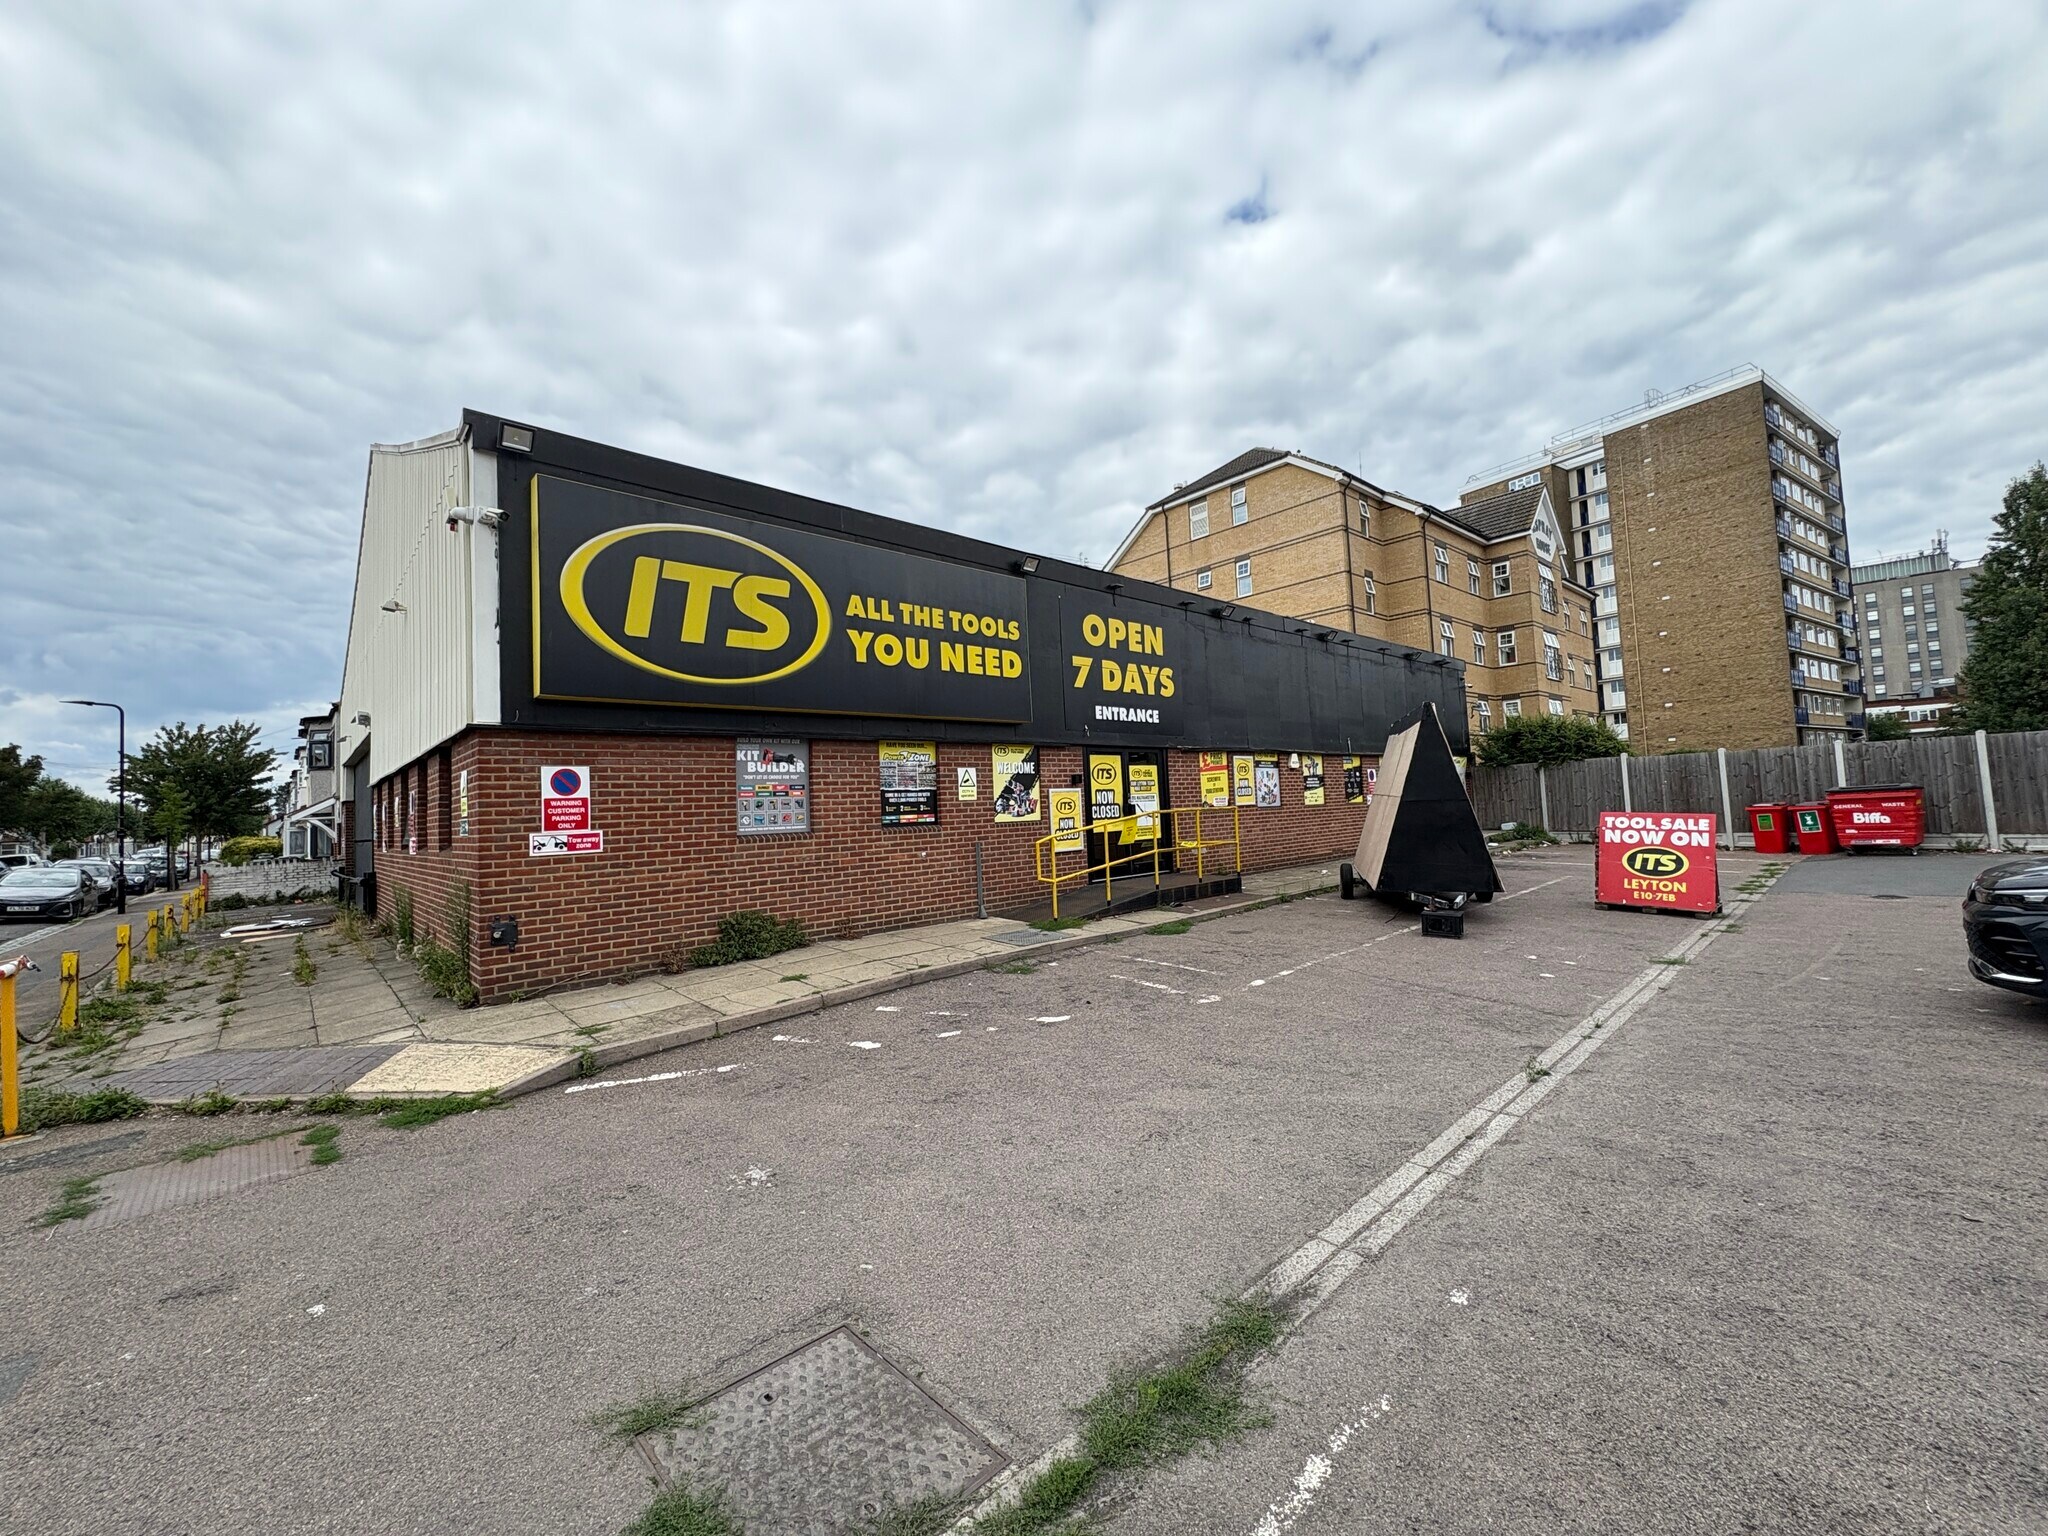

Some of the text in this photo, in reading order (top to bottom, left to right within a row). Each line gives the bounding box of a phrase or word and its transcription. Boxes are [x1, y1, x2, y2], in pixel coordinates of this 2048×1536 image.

[624, 556, 791, 652] ITS
[845, 594, 1020, 641] ALL THE TOOLS
[1082, 614, 1164, 656] OPEN
[846, 629, 1023, 680] YOU NEED
[1072, 656, 1175, 698] 7 DAYS
[1095, 706, 1160, 723] ENTRANCE
[737, 750, 760, 761] KIT
[747, 760, 805, 772] BUILDER
[996, 762, 1035, 774] WELCOME
[1097, 768, 1112, 779] ITS
[1096, 791, 1114, 804] NOW
[1060, 802, 1072, 810] ITS
[1092, 805, 1119, 818] CLOSED
[1060, 819, 1074, 829] NOW
[1605, 817, 1709, 831] TOOL SALE
[1853, 812, 1891, 823] Biffa
[1605, 830, 1709, 847] NOW ON
[1634, 853, 1676, 871] ITS
[1624, 878, 1687, 893] LEYTON
